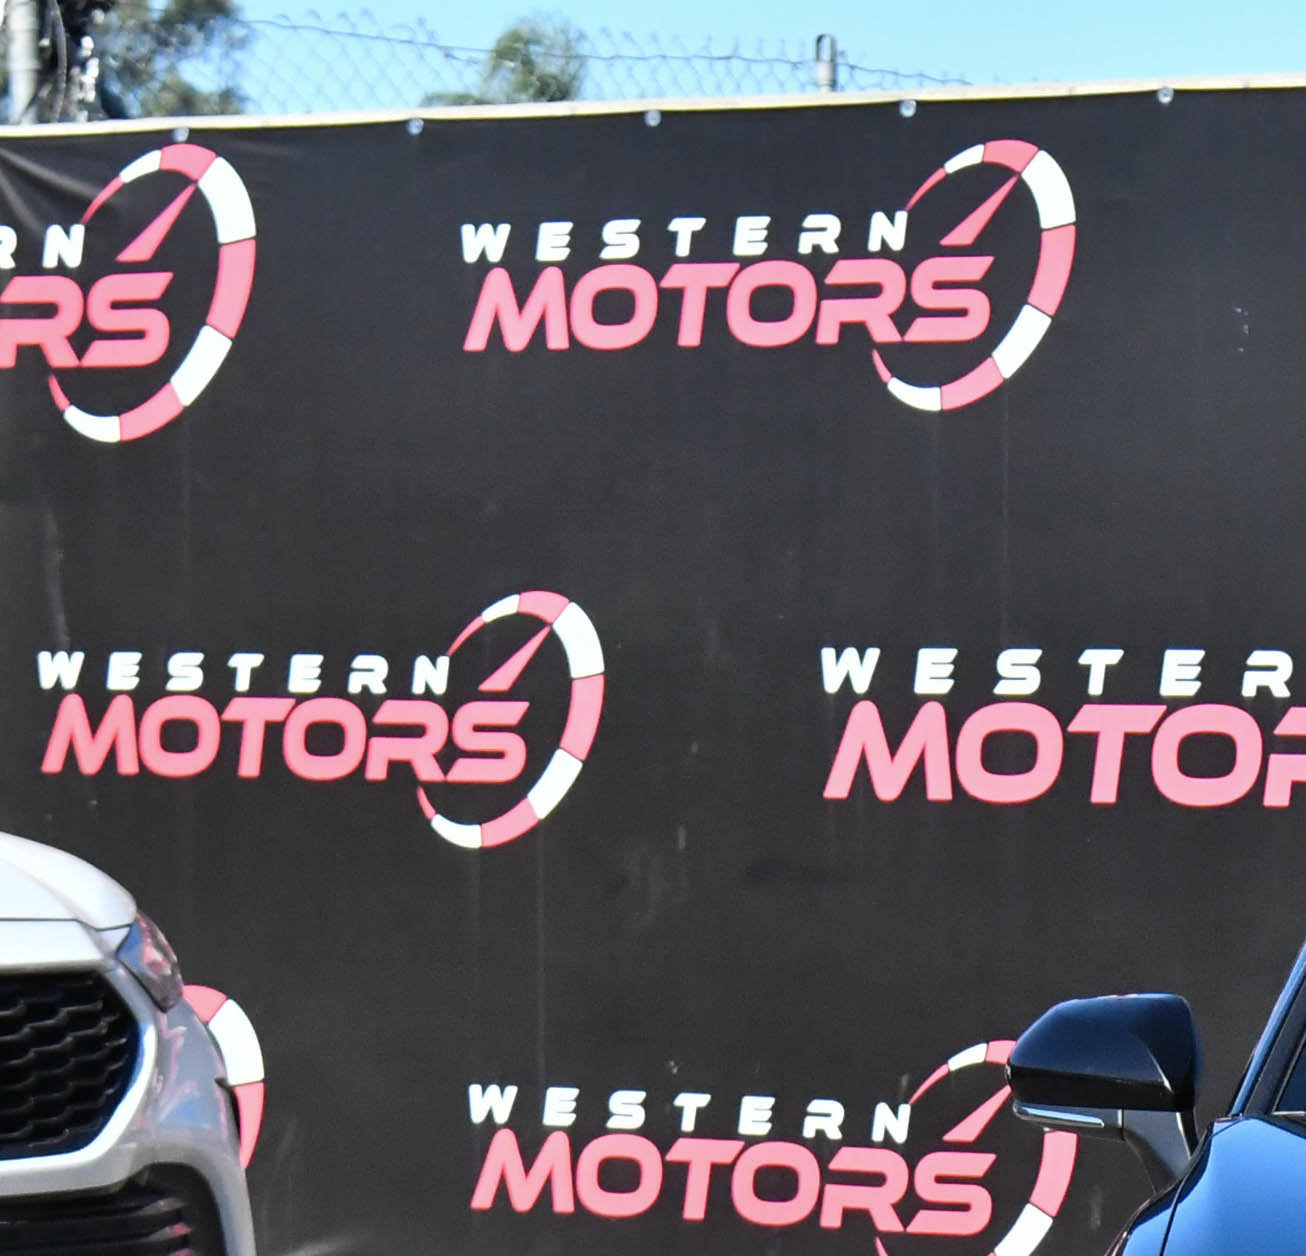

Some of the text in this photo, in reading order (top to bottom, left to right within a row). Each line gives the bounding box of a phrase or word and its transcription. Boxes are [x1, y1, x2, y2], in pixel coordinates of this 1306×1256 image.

[461, 210, 909, 264] WESTERN
[464, 255, 995, 353] MOTORS
[37, 650, 450, 696] WESTERN
[40, 692, 531, 784] MOTORS
[468, 1083, 912, 1144] WESTERN
[470, 1127, 997, 1237] MOTORS
